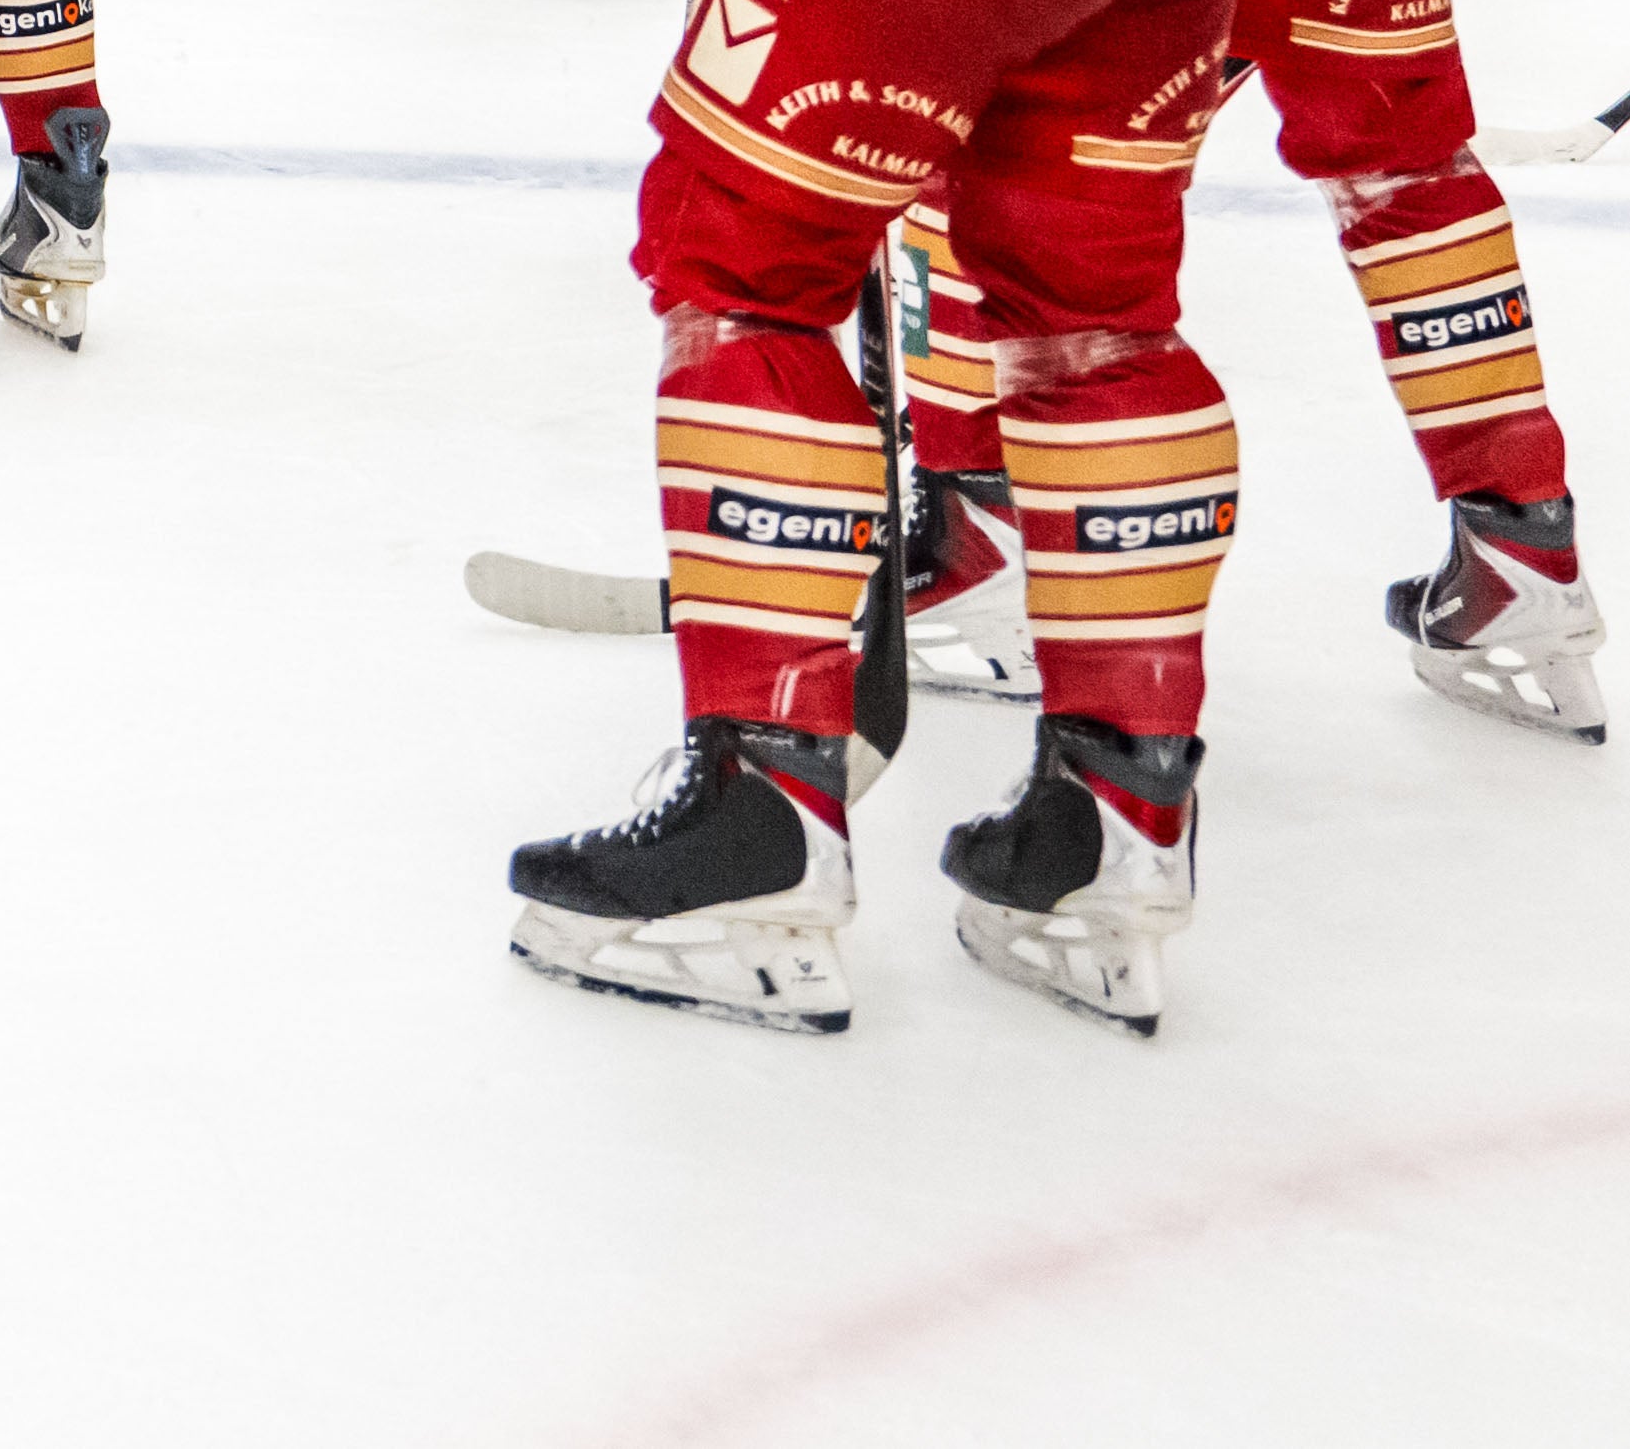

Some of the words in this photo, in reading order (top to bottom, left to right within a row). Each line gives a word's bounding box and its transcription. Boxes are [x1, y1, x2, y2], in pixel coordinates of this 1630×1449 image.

[765, 79, 845, 131] KEITH
[848, 79, 870, 104] &
[879, 83, 935, 116] SON
